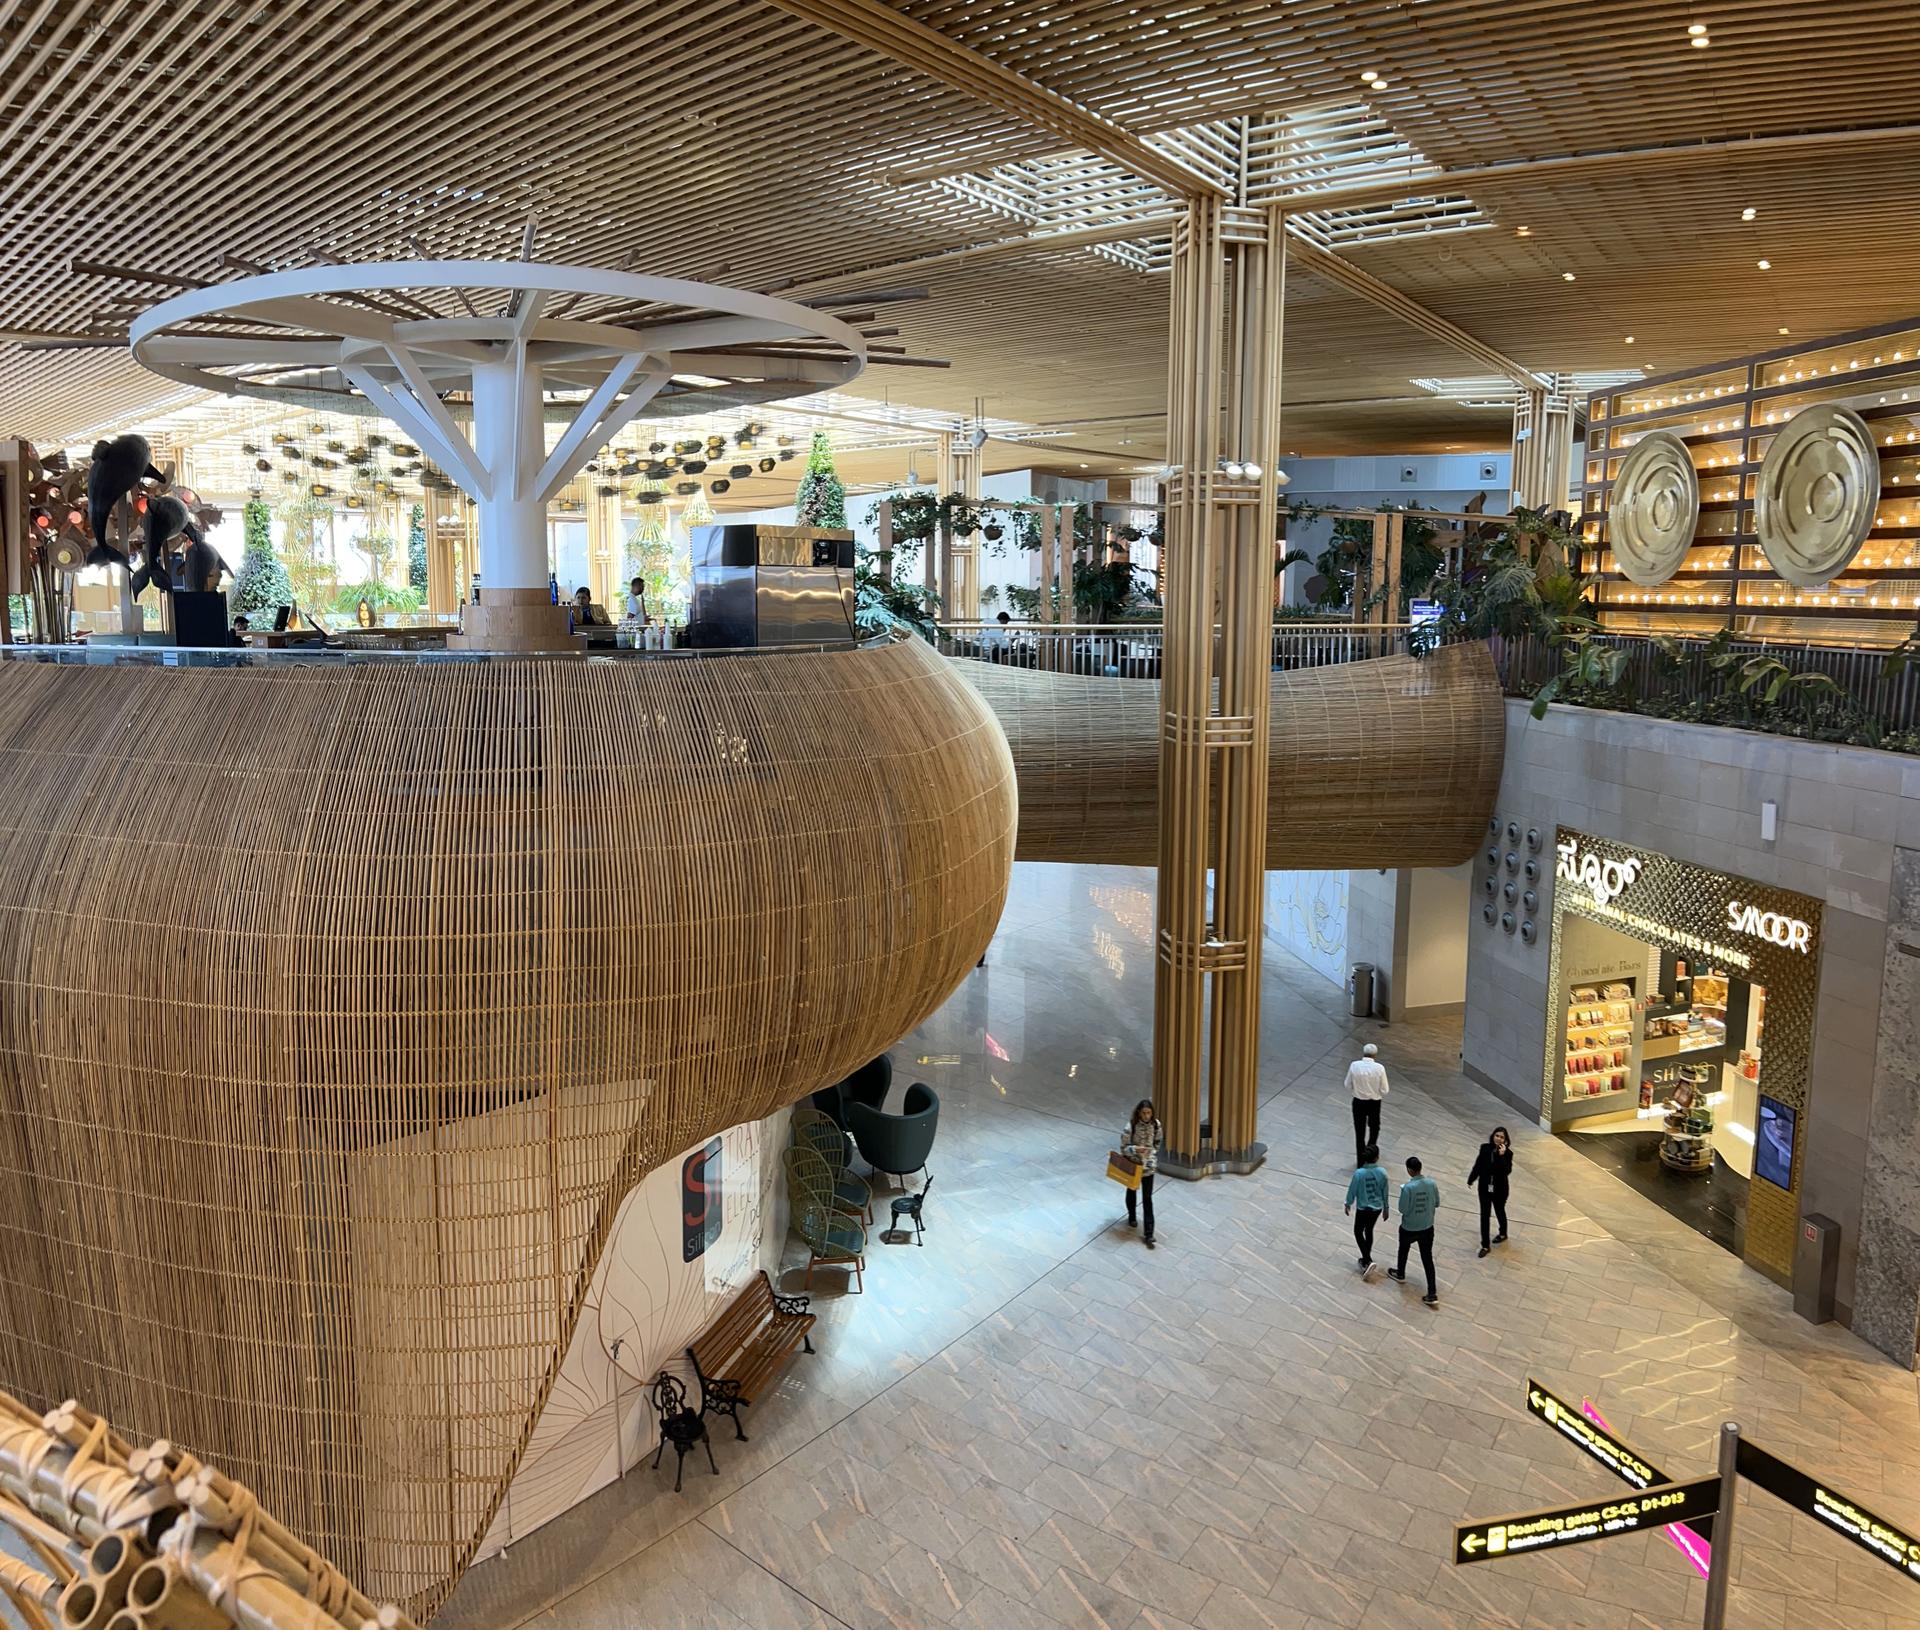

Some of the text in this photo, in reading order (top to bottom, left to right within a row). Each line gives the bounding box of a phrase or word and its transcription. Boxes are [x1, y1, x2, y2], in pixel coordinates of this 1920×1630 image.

[1572, 893, 1751, 970] ARTISANAL CHOCOLATES & MORE
[1727, 901, 1809, 954] SMOOR
[1507, 1518, 1565, 1537] Boarding
[1565, 1511, 1601, 1529] gates
[1641, 1491, 1686, 1512] D1-D13
[1815, 1488, 1870, 1532] Boarding
[1870, 1524, 1907, 1552] gates
